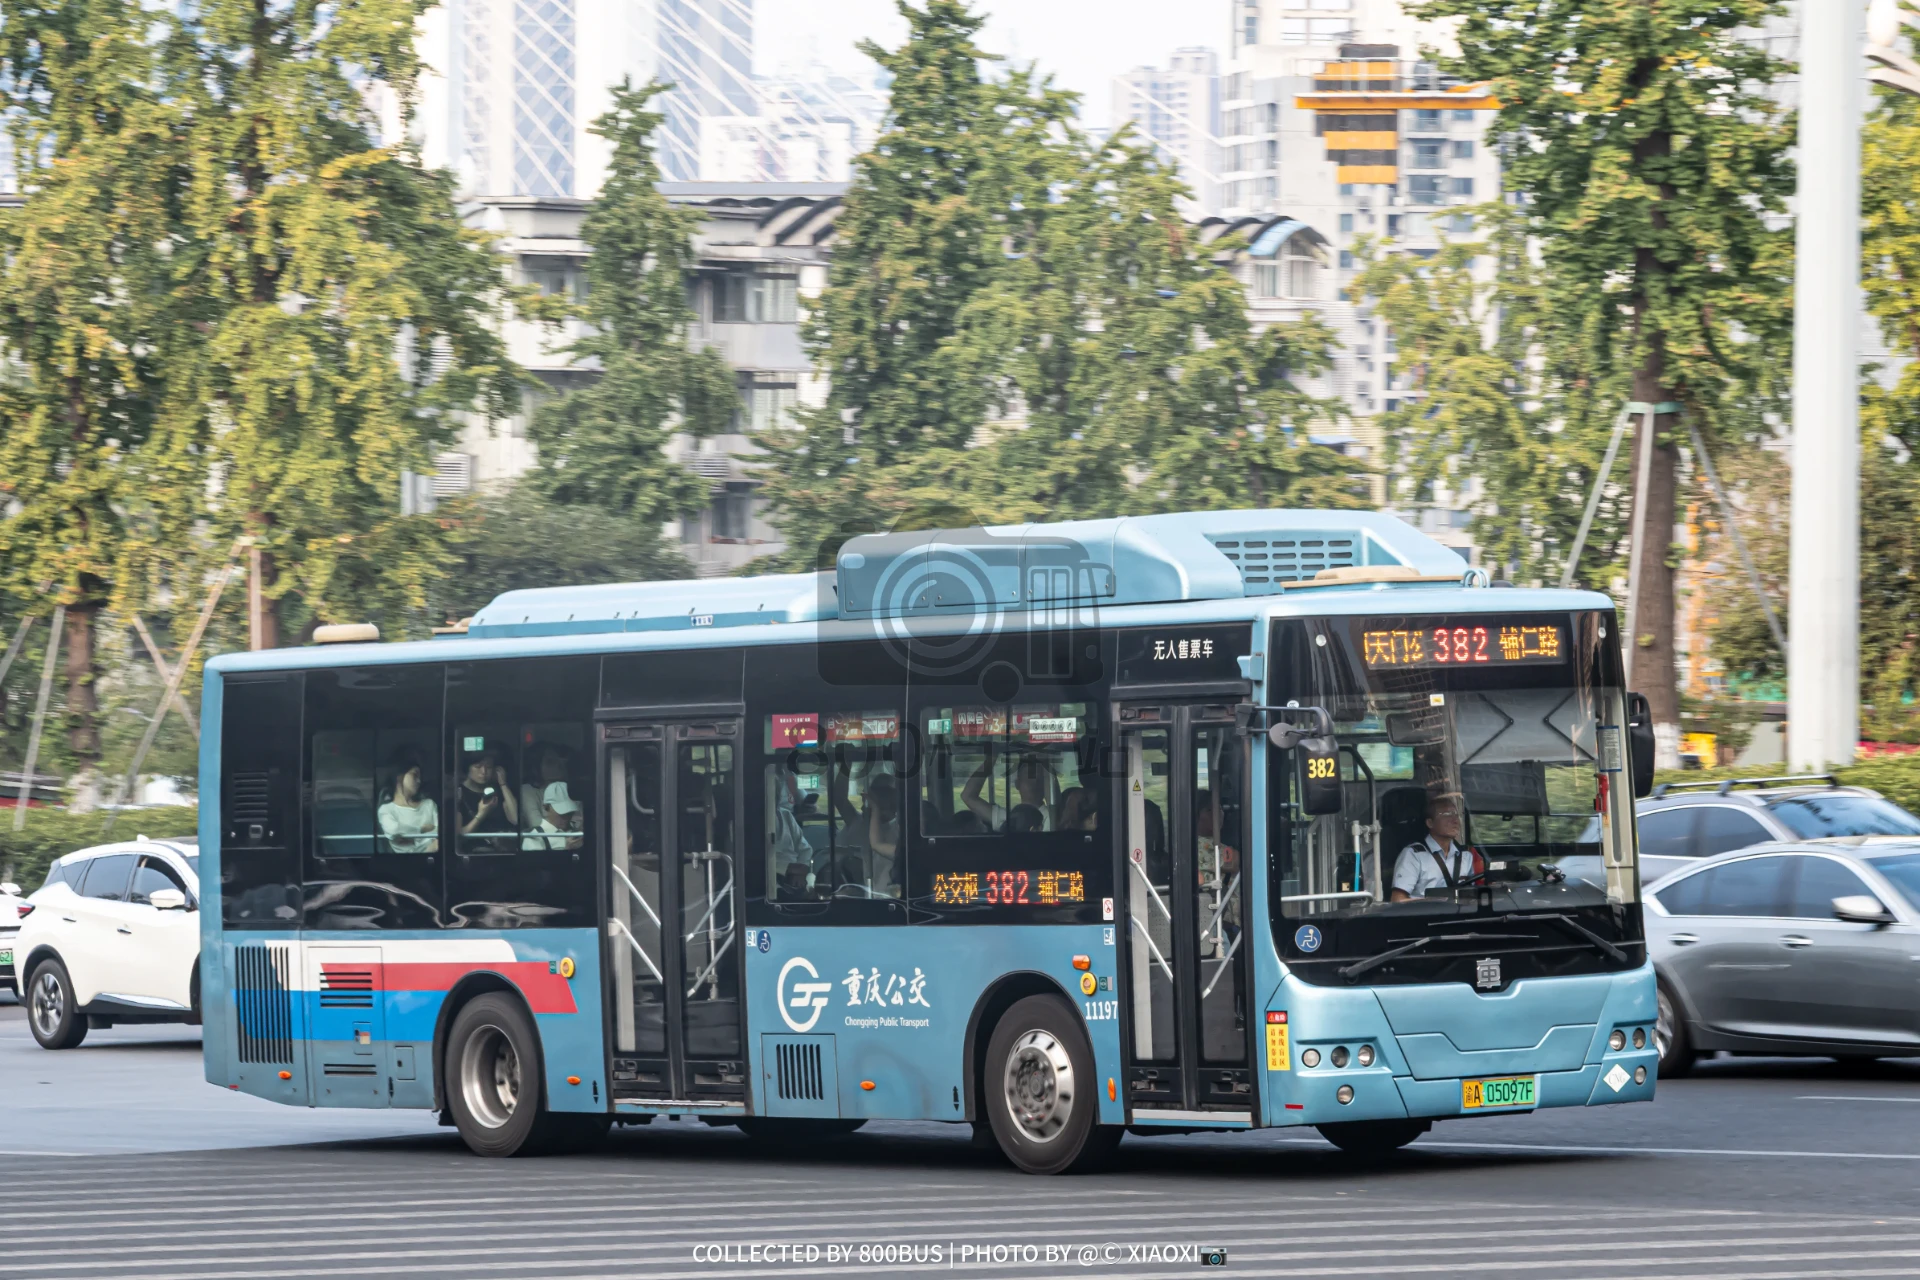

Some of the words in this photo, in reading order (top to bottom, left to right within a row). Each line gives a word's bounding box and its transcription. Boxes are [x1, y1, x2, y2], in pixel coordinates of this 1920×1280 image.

[1153, 638, 1214, 660] 无人售票车
[1433, 626, 1489, 662] 382
[1308, 757, 1335, 779] 382
[986, 870, 1029, 904] 382
[841, 967, 931, 1008] 重庆公交
[1085, 1000, 1118, 1020] 11197
[844, 1016, 879, 1029] Chongqing
[880, 1016, 899, 1027] Public
[900, 1016, 930, 1029] Transport
